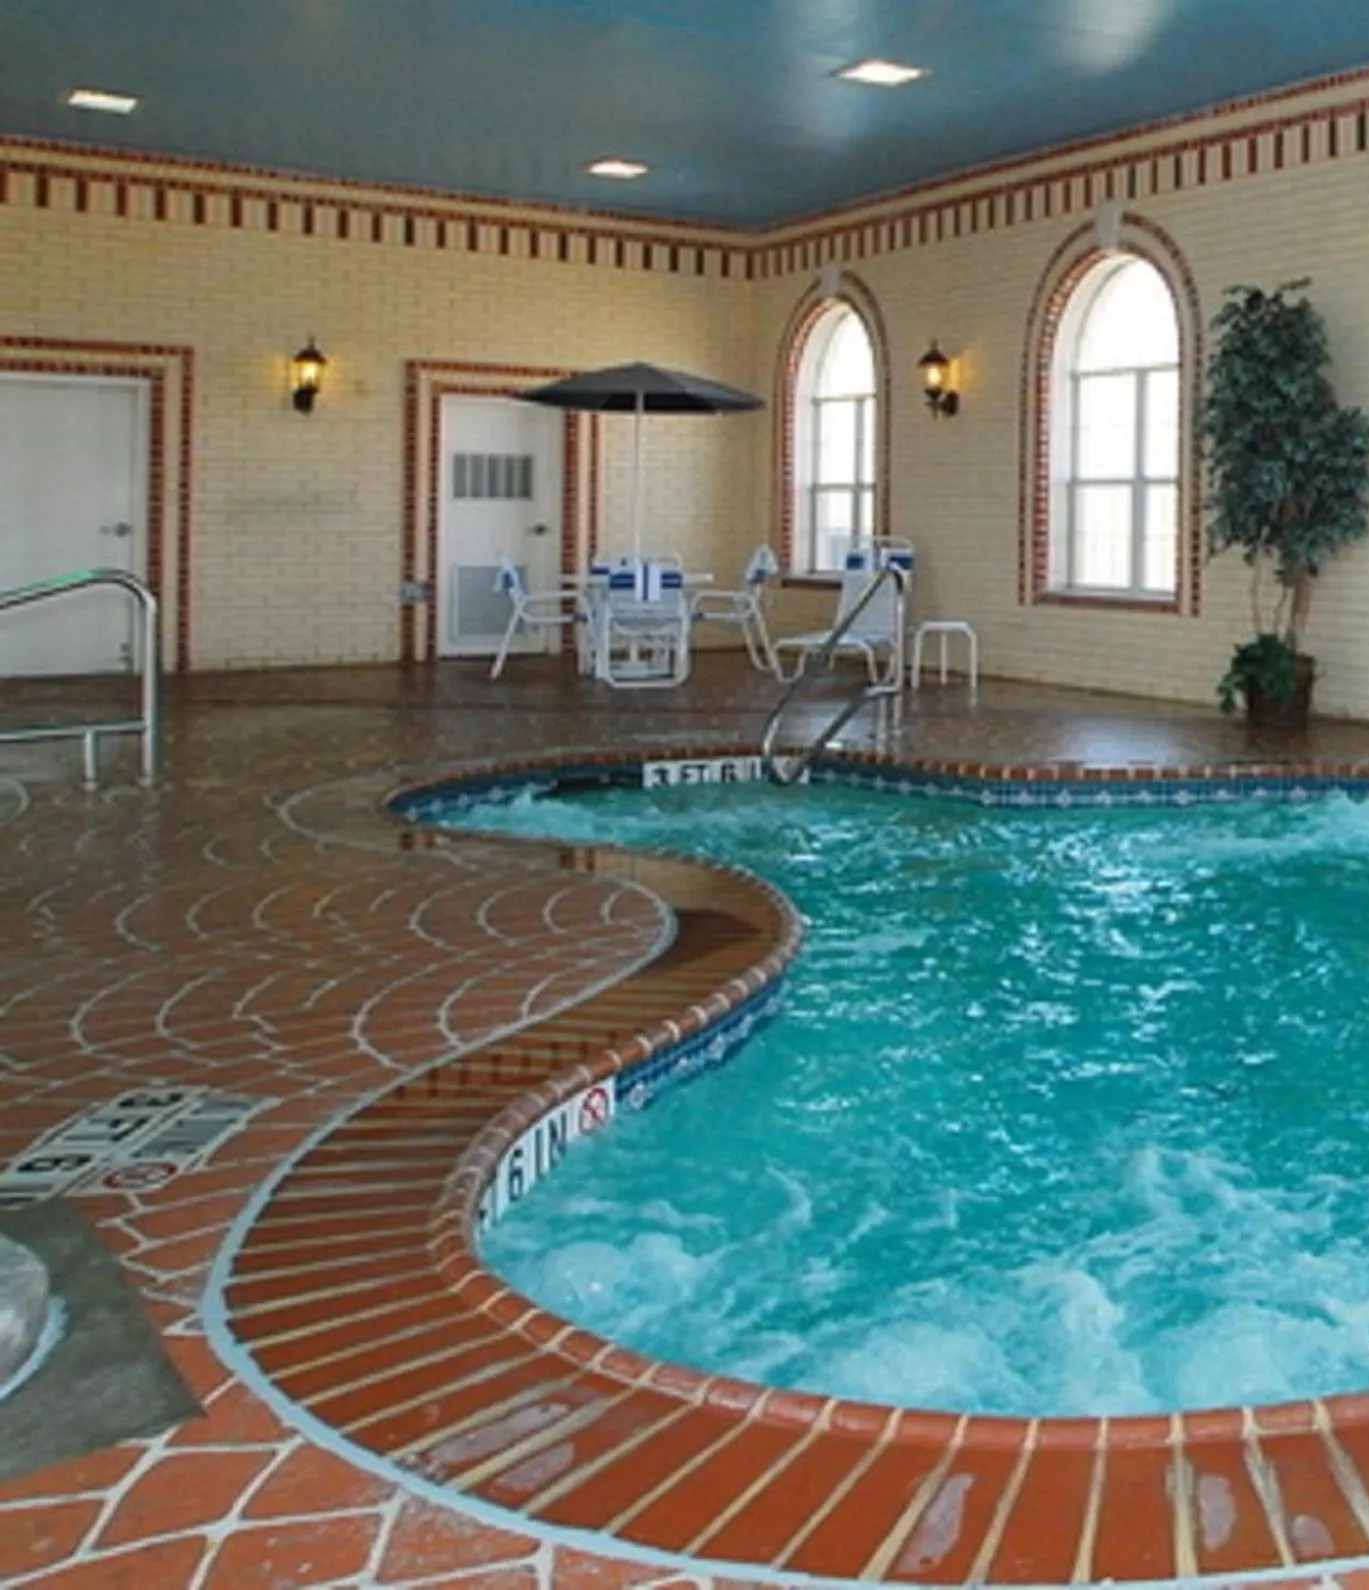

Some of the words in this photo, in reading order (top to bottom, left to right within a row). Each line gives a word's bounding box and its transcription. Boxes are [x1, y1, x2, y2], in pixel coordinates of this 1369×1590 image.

[18, 1154, 92, 1173] 6
[510, 1148, 523, 1201] 6
[535, 1112, 569, 1179] IN
